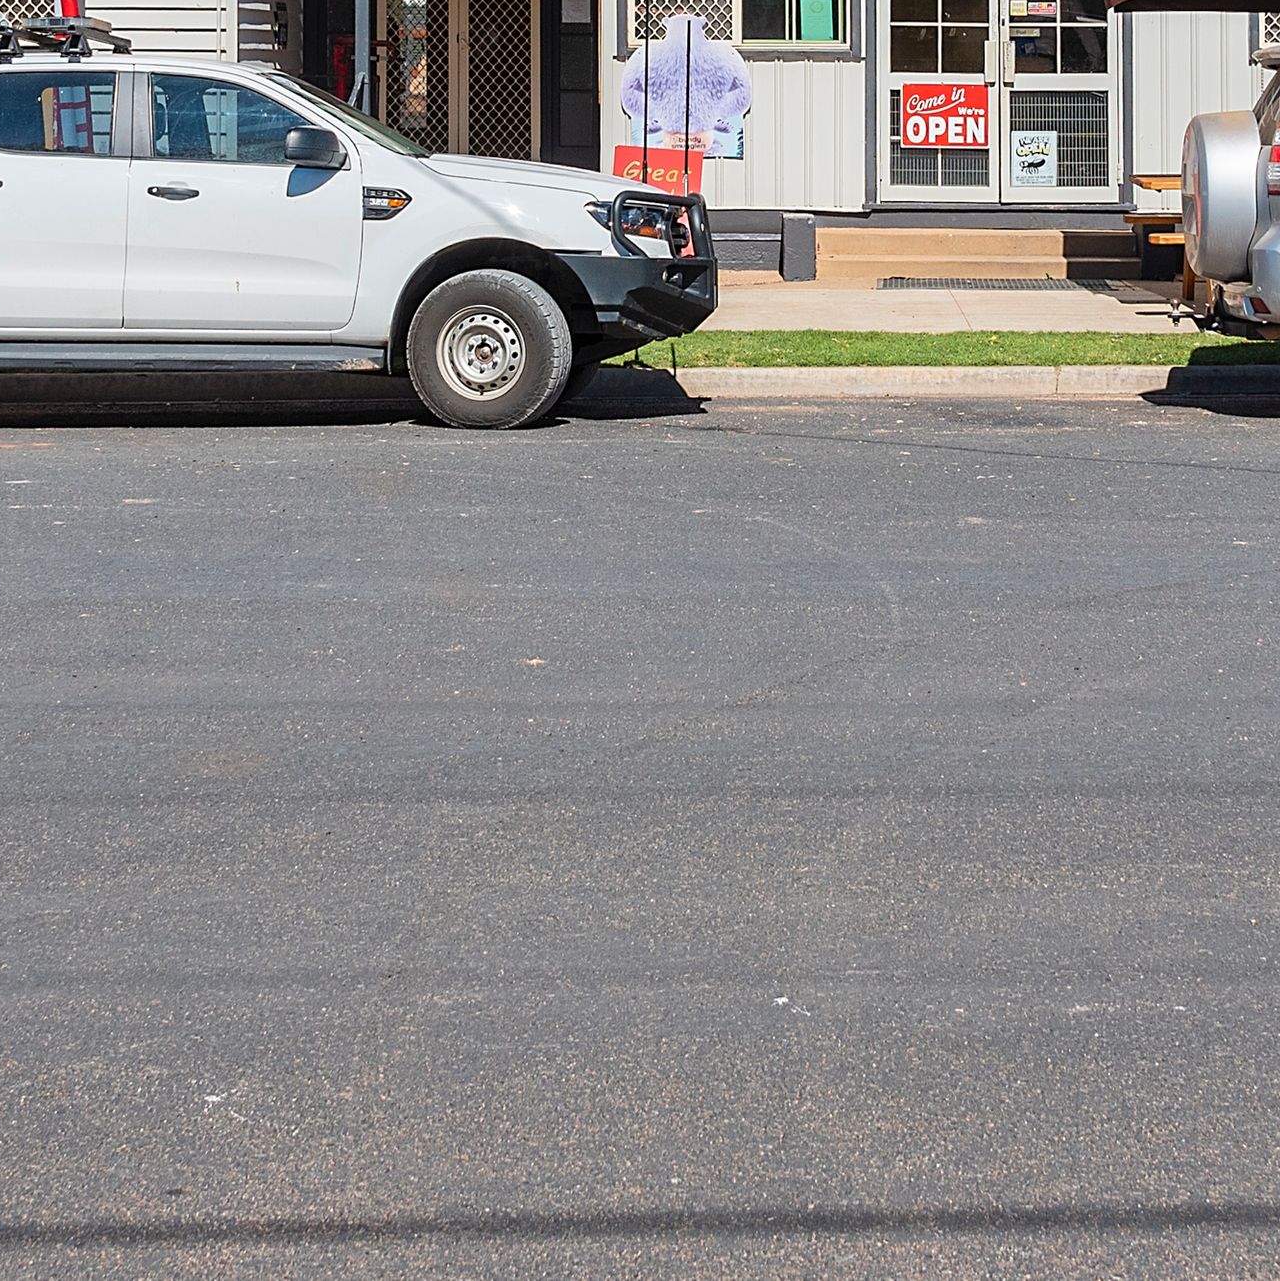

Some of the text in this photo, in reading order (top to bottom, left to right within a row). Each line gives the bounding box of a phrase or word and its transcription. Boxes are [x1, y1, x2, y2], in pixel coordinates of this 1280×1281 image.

[906, 87, 966, 114] Come in
[958, 107, 985, 116] We're
[906, 116, 985, 144] OPEN
[623, 160, 692, 184] Great
